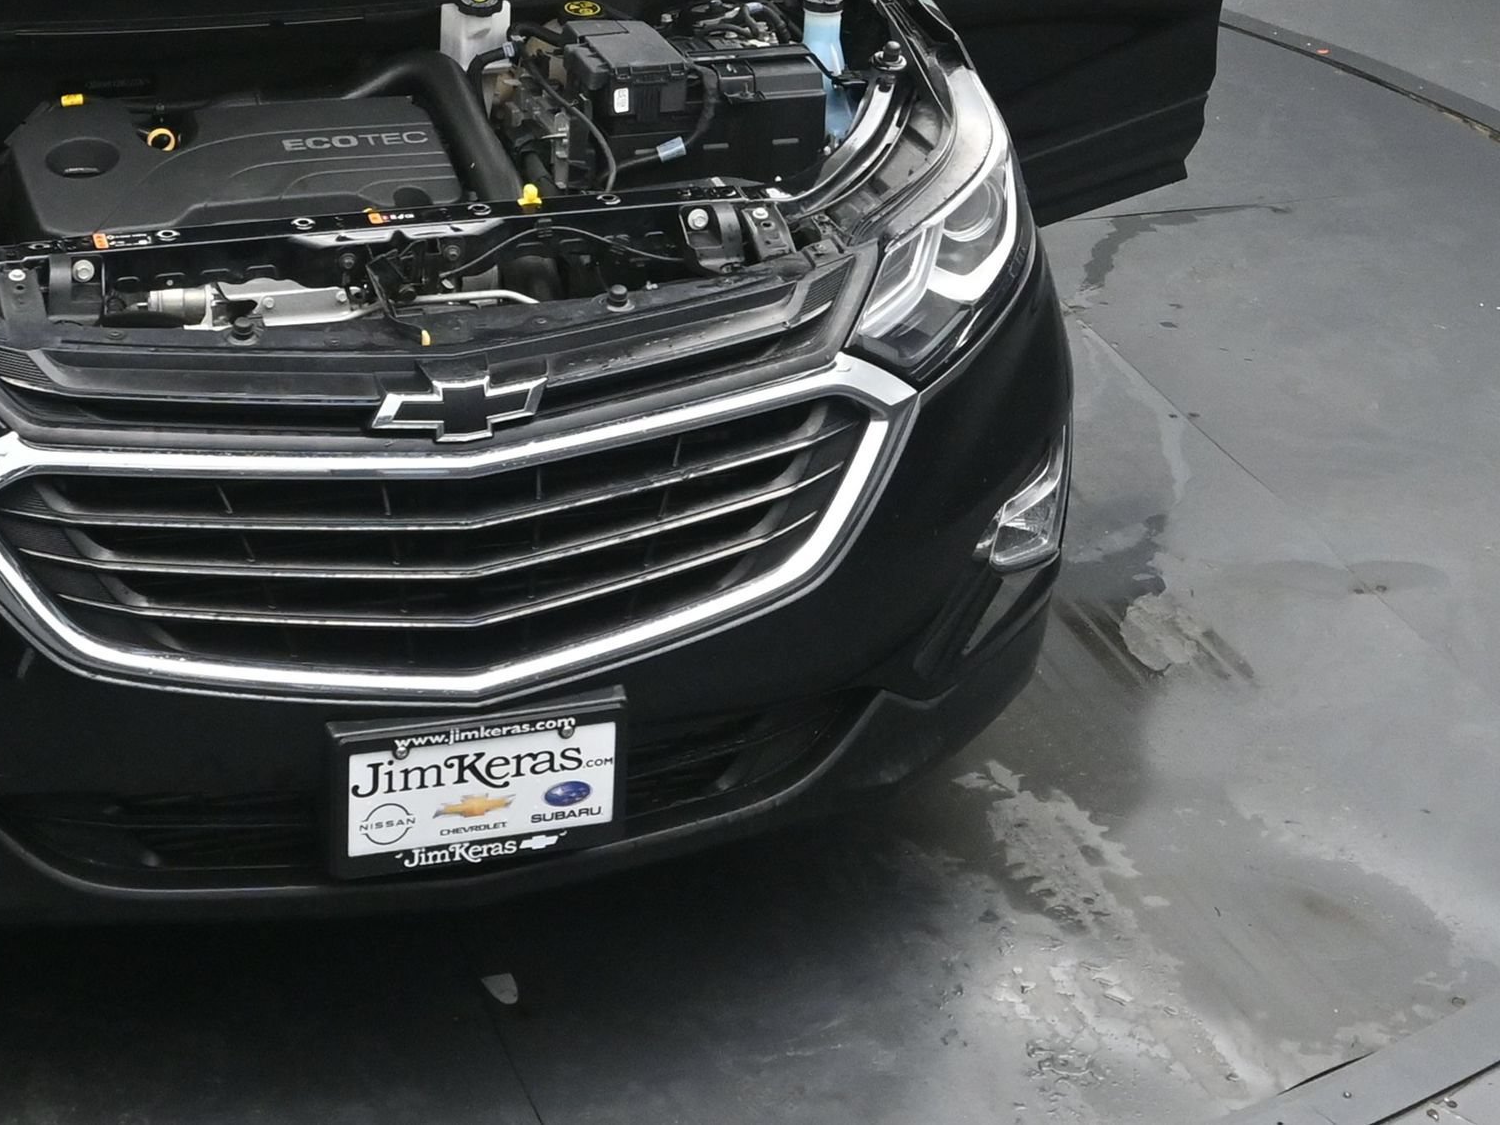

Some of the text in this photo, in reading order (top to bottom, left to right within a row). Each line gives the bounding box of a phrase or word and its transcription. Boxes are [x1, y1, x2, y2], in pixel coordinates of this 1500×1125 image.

[281, 131, 429, 151] ECOTEC
[393, 716, 576, 748] www.jimkeras.com
[359, 816, 416, 832] NISSAN
[530, 806, 602, 824] SUBARU
[439, 821, 508, 836] CHEVROLET
